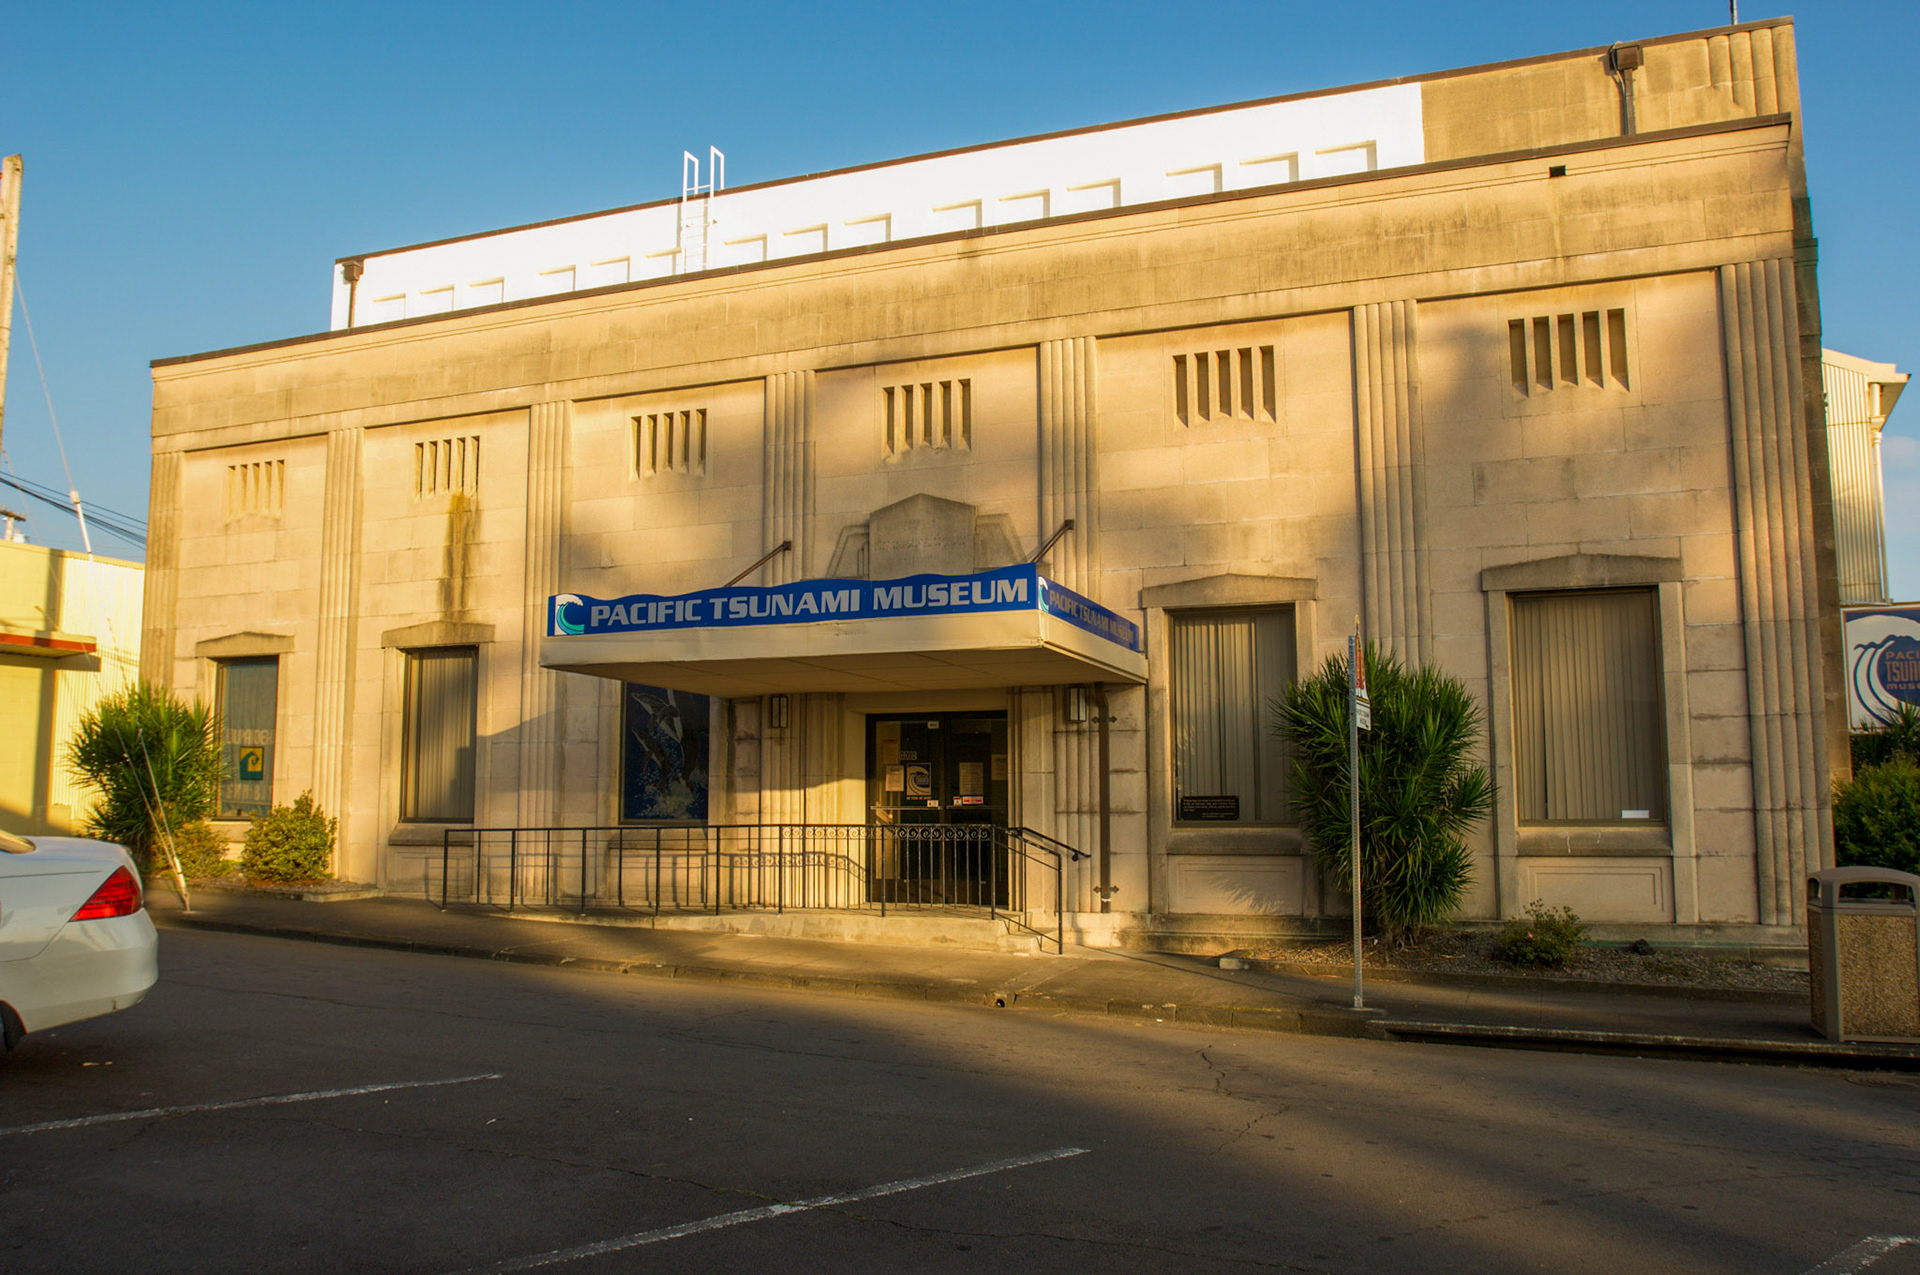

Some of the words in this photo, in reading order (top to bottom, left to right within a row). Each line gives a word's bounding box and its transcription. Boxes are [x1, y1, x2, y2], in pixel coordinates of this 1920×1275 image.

[591, 600, 701, 627] PACIFIC
[708, 590, 860, 619] TSUNAMI
[873, 578, 1028, 610] MUSEUM
[1049, 590, 1078, 617] PACIFIC
